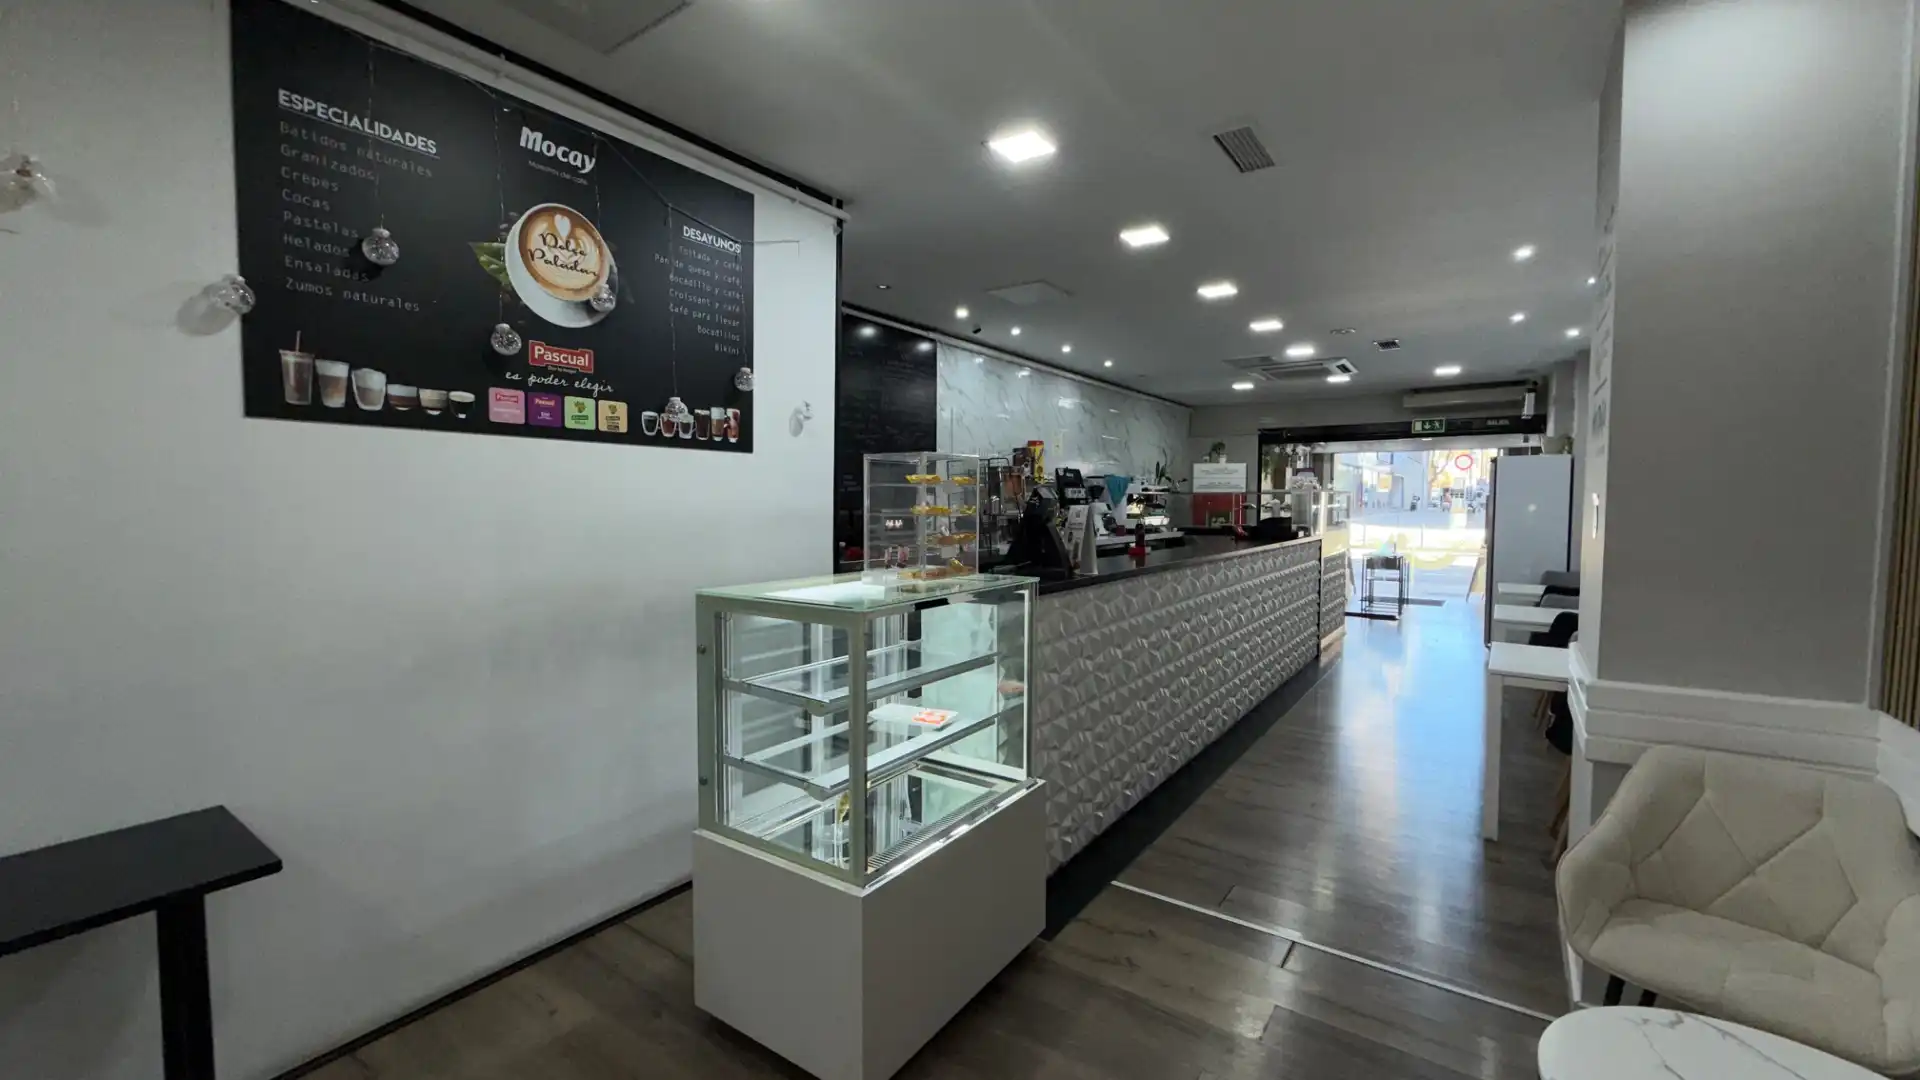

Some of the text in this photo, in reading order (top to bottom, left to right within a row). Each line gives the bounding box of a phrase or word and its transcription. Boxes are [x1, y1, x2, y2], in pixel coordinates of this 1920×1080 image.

[278, 88, 437, 154] ESPECIALIDADES
[280, 120, 347, 151] Batidos
[280, 143, 375, 180] Granizados
[520, 126, 596, 174] Mocay
[281, 166, 339, 192] Crepes
[282, 188, 330, 212] Cocas
[283, 233, 350, 257] Helados
[683, 225, 742, 253] DESAYUNOS
[285, 255, 369, 282] Ensaladas
[527, 248, 600, 277] Paladar
[654, 253, 670, 265] Pan
[286, 277, 420, 312] Zumos naturales
[534, 345, 589, 367] Pascual
[505, 371, 614, 397] es poder elegir
